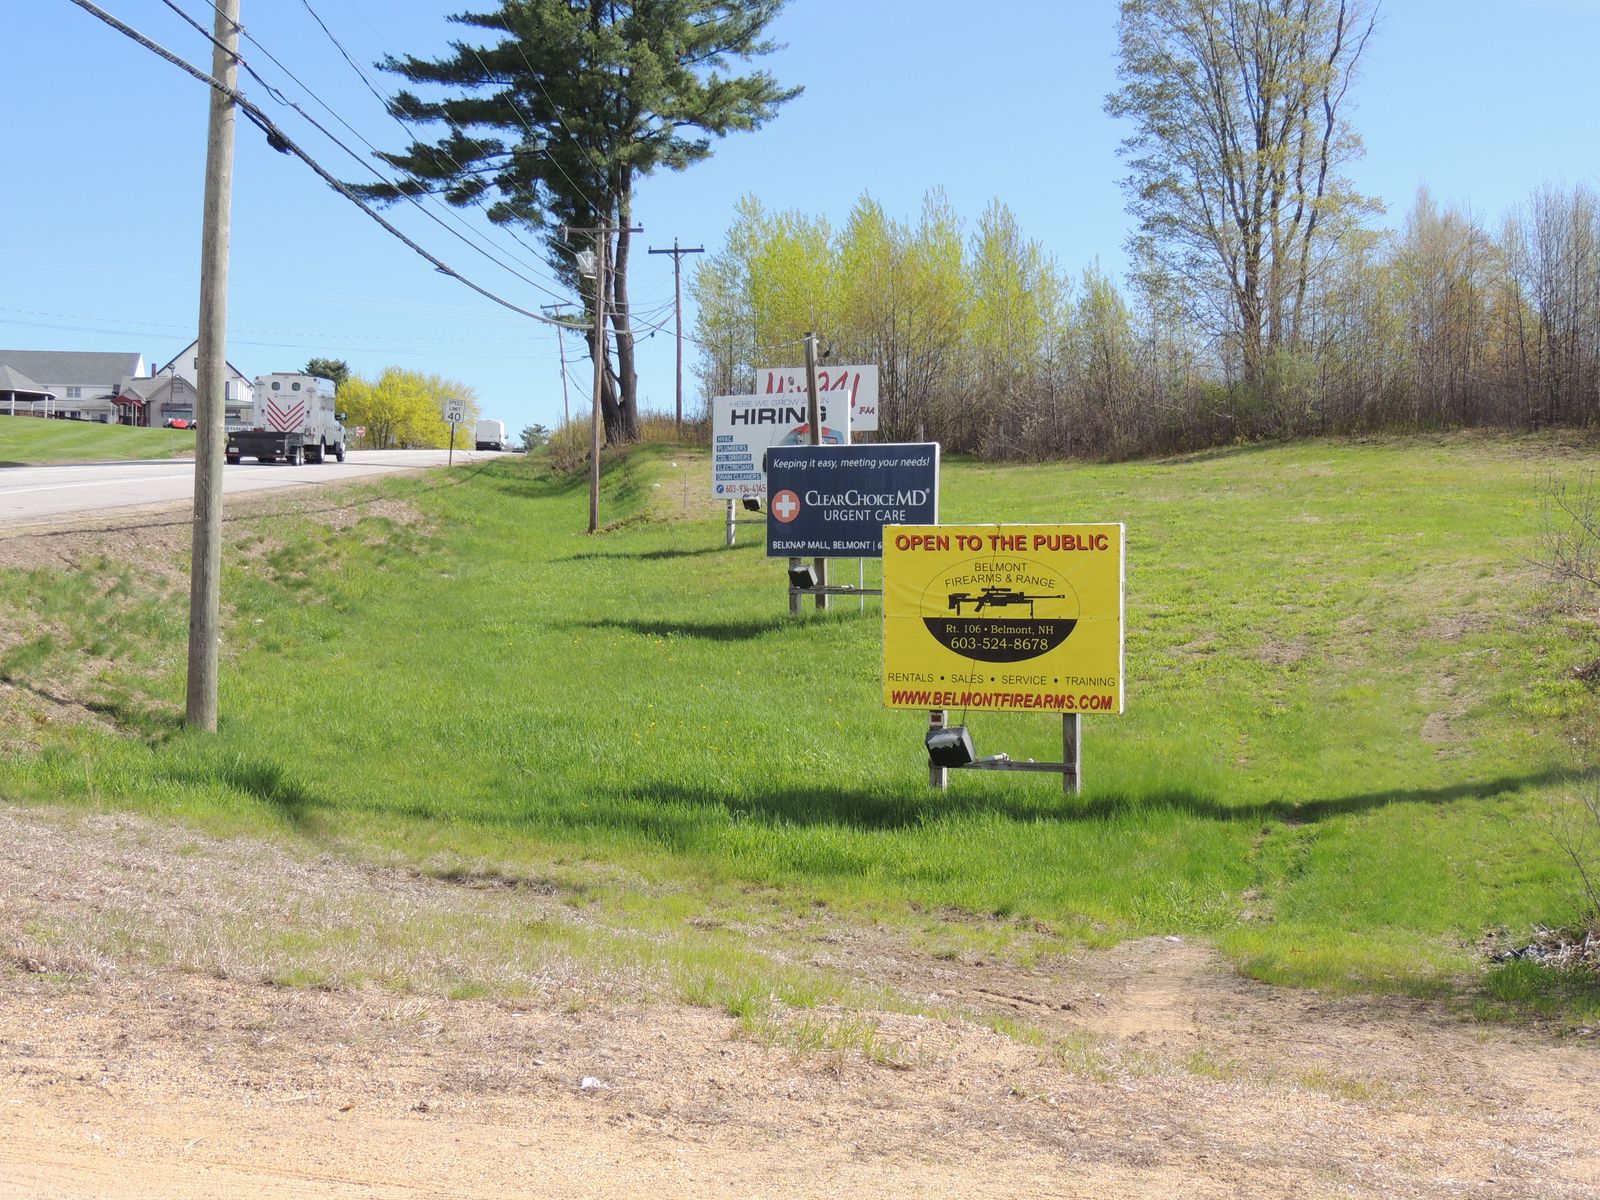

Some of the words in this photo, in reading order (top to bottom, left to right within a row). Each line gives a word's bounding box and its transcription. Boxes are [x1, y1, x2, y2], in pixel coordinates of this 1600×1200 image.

[858, 406, 875, 414] FM
[448, 412, 460, 422] 40
[774, 458, 808, 470] Keeping
[810, 458, 816, 468] it
[818, 460, 838, 470] easy,
[840, 458, 876, 470] meeting
[878, 460, 898, 468] your
[900, 456, 930, 466] needs!
[824, 510, 872, 522] URGENT
[875, 510, 906, 522] CARE
[772, 541, 806, 550] BELKNAP
[808, 541, 830, 550] MALL,
[832, 541, 870, 550] BELMONT
[895, 534, 950, 551] OPEN
[955, 534, 982, 551] TO
[988, 534, 1028, 551] THE
[1033, 534, 1109, 551] PUBLIC
[974, 562, 1028, 572] BELMONT
[945, 574, 1002, 589] FIREARMS
[1005, 574, 1012, 583] &
[1016, 574, 1056, 589] RANGE
[946, 624, 960, 634] Rt.
[964, 624, 981, 634] 106
[990, 624, 1034, 636] Belmont,
[1038, 626, 1054, 634] NH
[951, 638, 1049, 651] 603-524-8678
[888, 673, 934, 683] RENTALS
[951, 674, 984, 684] SALES
[1001, 675, 1047, 686] SERVICE
[1065, 676, 1116, 687] TRAINING
[892, 690, 1113, 710] WWW.BELMONTFIREARMS.COM
